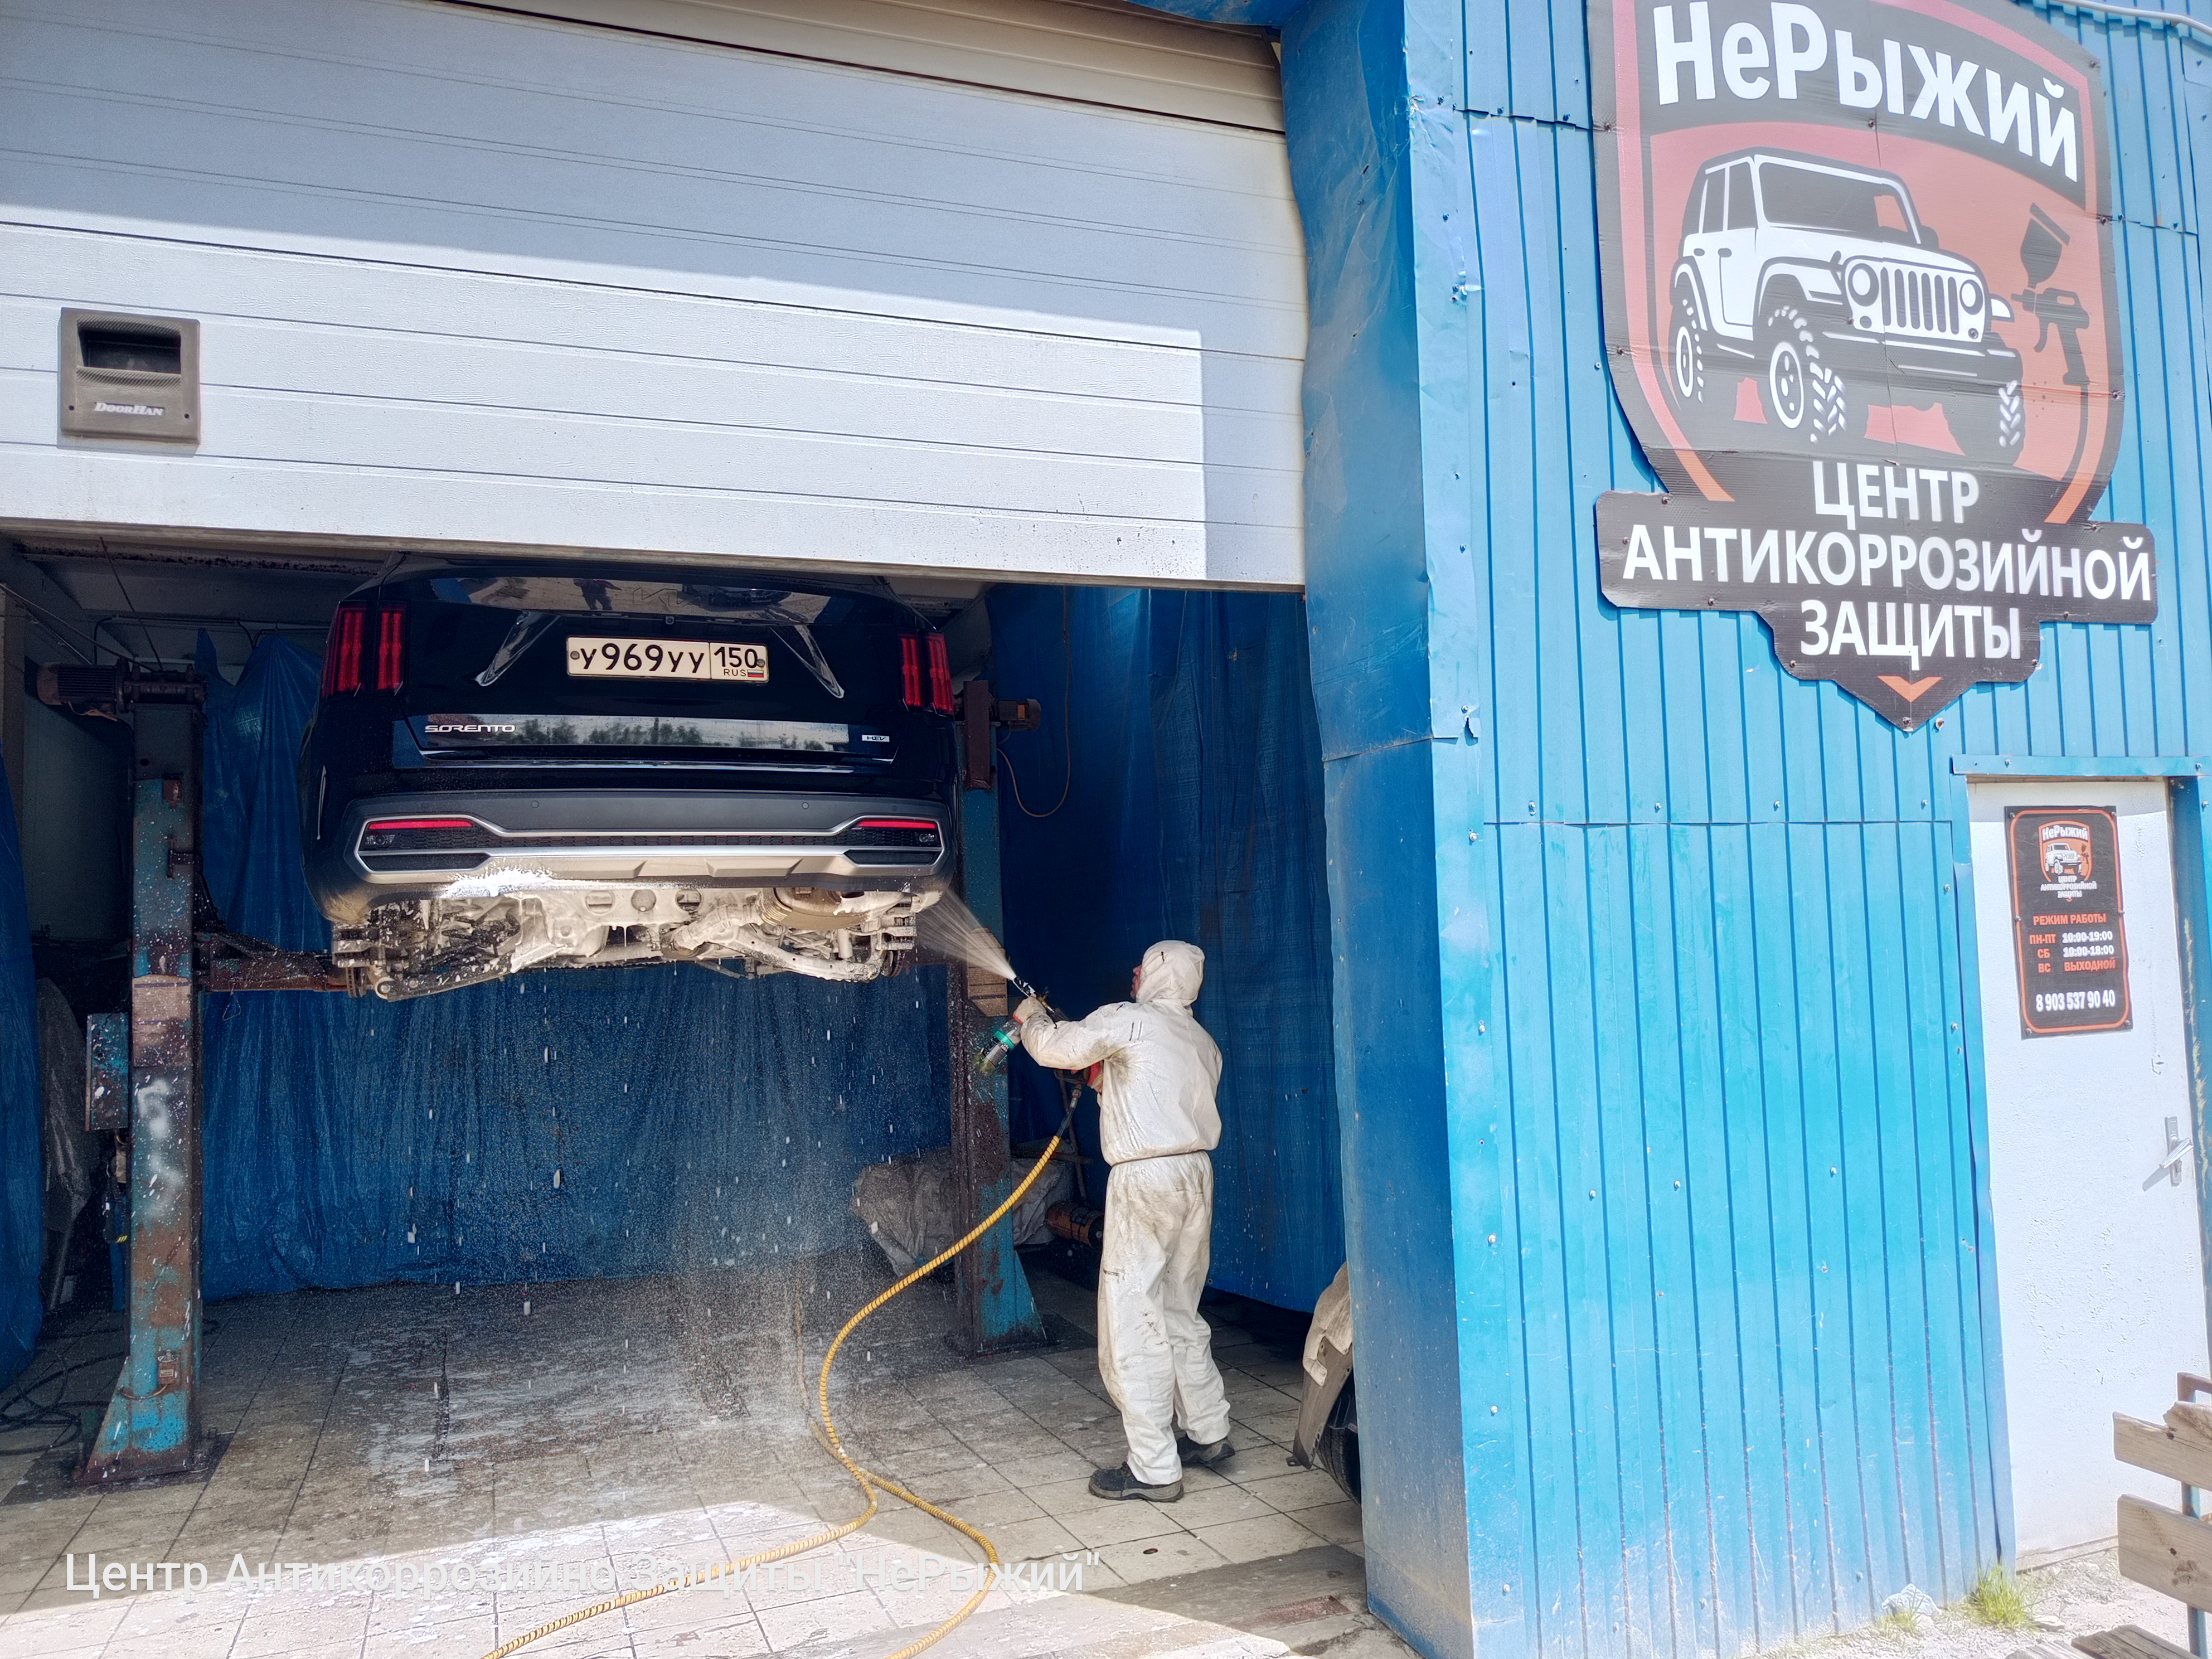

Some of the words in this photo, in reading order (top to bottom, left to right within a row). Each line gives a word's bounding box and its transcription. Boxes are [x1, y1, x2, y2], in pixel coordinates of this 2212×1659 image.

[1812, 460, 1980, 531] ЦЕНТР
[1622, 524, 2152, 601] АНТИКОРРОЗИЙНОЙ
[1800, 599, 2021, 671] ЗАЩИТЫ
[714, 646, 759, 669] 150
[724, 668, 746, 677] RUS
[2033, 914, 2068, 925] РЕЖИМ
[2070, 913, 2107, 924] РАБОТЫ
[2029, 933, 2056, 944] ПН-ПТ
[2062, 931, 2113, 943] 10:00-19:00
[2037, 948, 2051, 958] СБ
[2063, 945, 2114, 958] 10:00-18:00
[2038, 962, 2051, 973] ВС
[2064, 957, 2116, 972] ВЫХОДНОЙ
[2036, 994, 2044, 1012] 8
[2045, 993, 2065, 1012] 903
[2067, 991, 2086, 1010] 537
[2087, 990, 2101, 1008] 90
[2102, 989, 2116, 1007] 40
